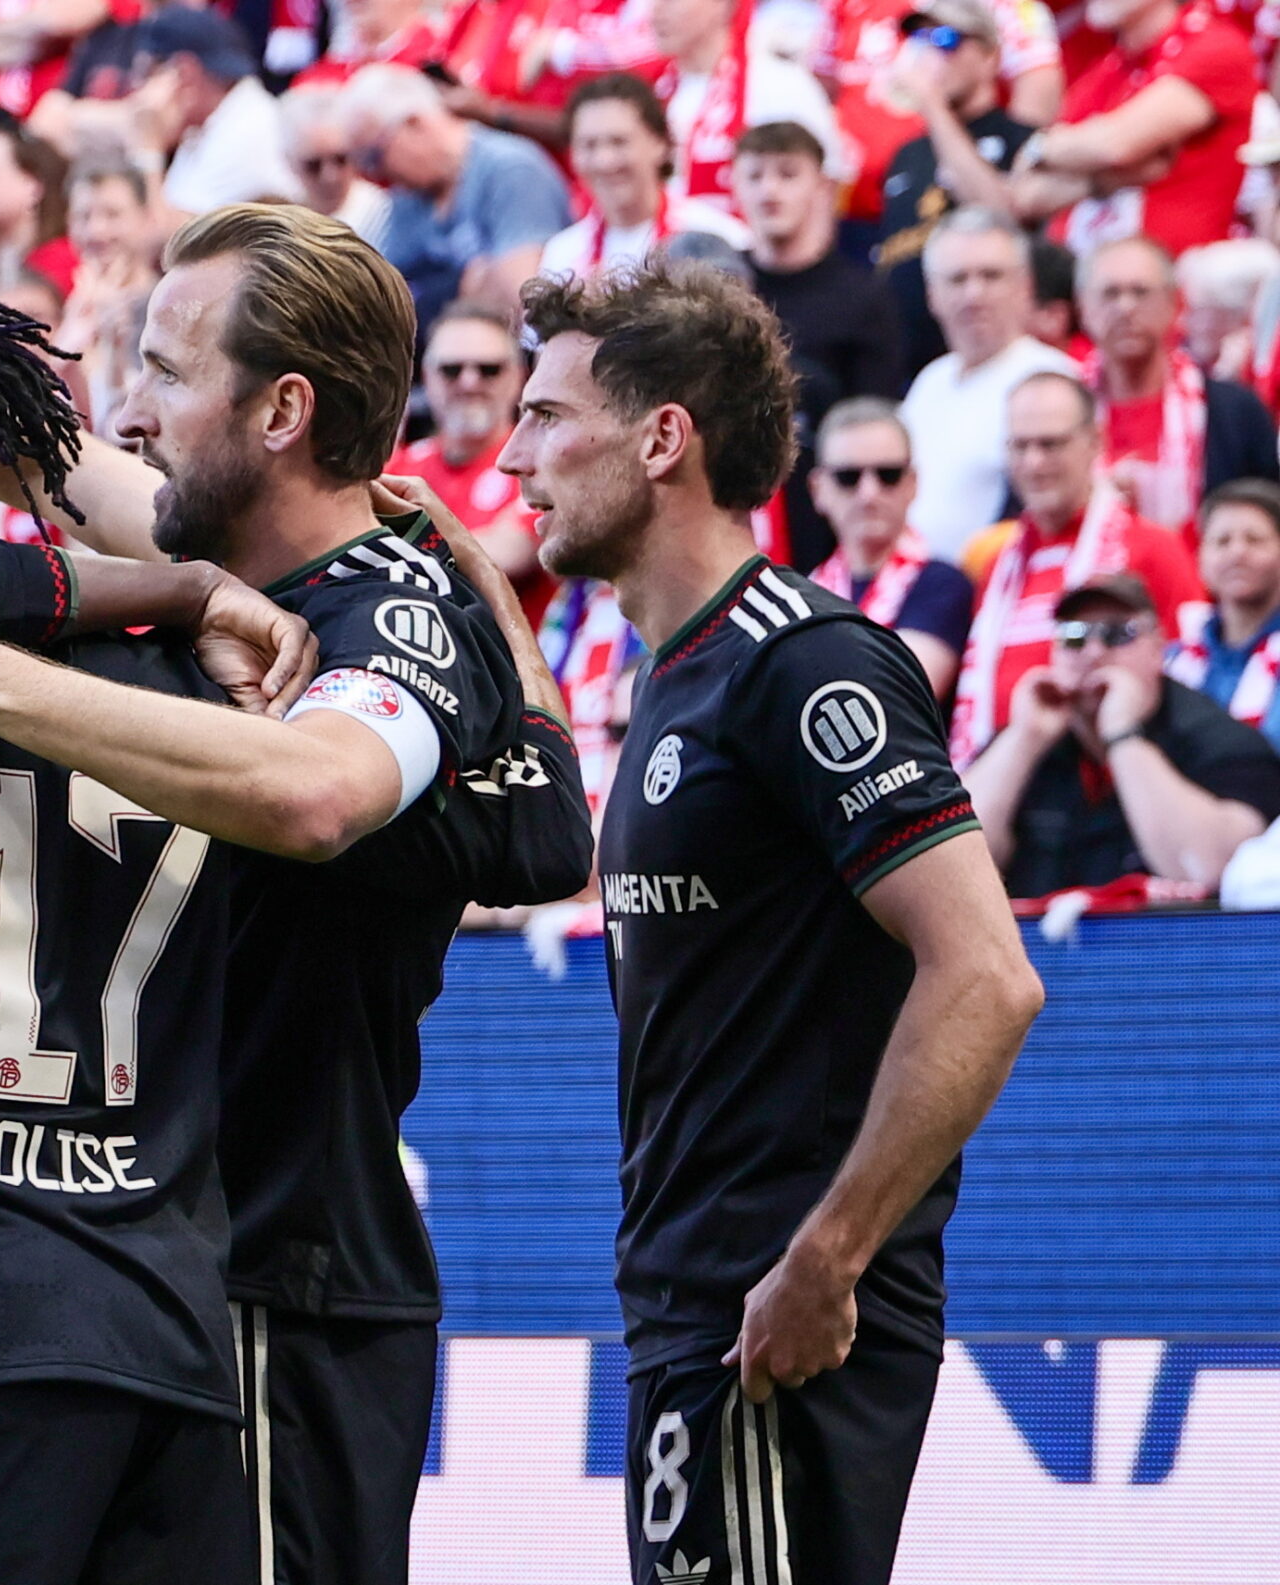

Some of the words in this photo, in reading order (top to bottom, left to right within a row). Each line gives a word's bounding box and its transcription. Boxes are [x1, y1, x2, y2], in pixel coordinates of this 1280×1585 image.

[367, 655, 460, 715] Allianz
[838, 759, 925, 822] Allianz
[604, 873, 719, 914] MAGENTA
[642, 1411, 690, 1543] 8
